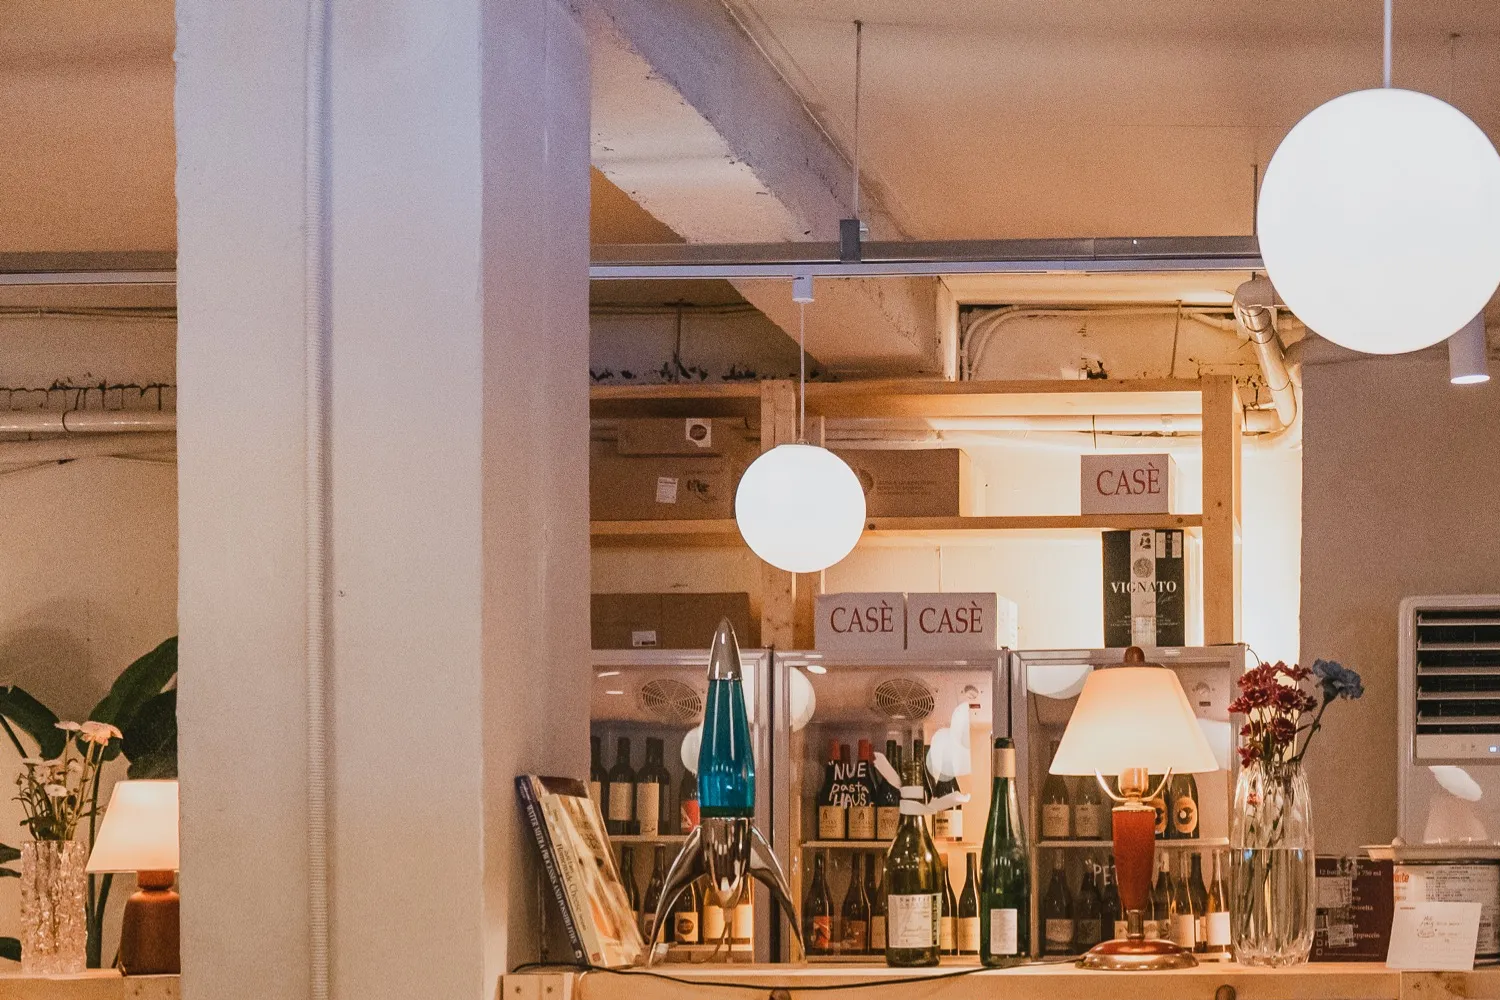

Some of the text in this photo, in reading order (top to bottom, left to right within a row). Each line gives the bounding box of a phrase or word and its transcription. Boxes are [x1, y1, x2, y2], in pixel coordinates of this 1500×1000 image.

[1096, 461, 1161, 496] CASÈ
[1111, 580, 1177, 594] VIGNATO
[830, 600, 894, 633] CASÈ
[919, 601, 983, 634] CASÈ
[554, 843, 574, 883] Homemade
[567, 882, 584, 912] Cheese
